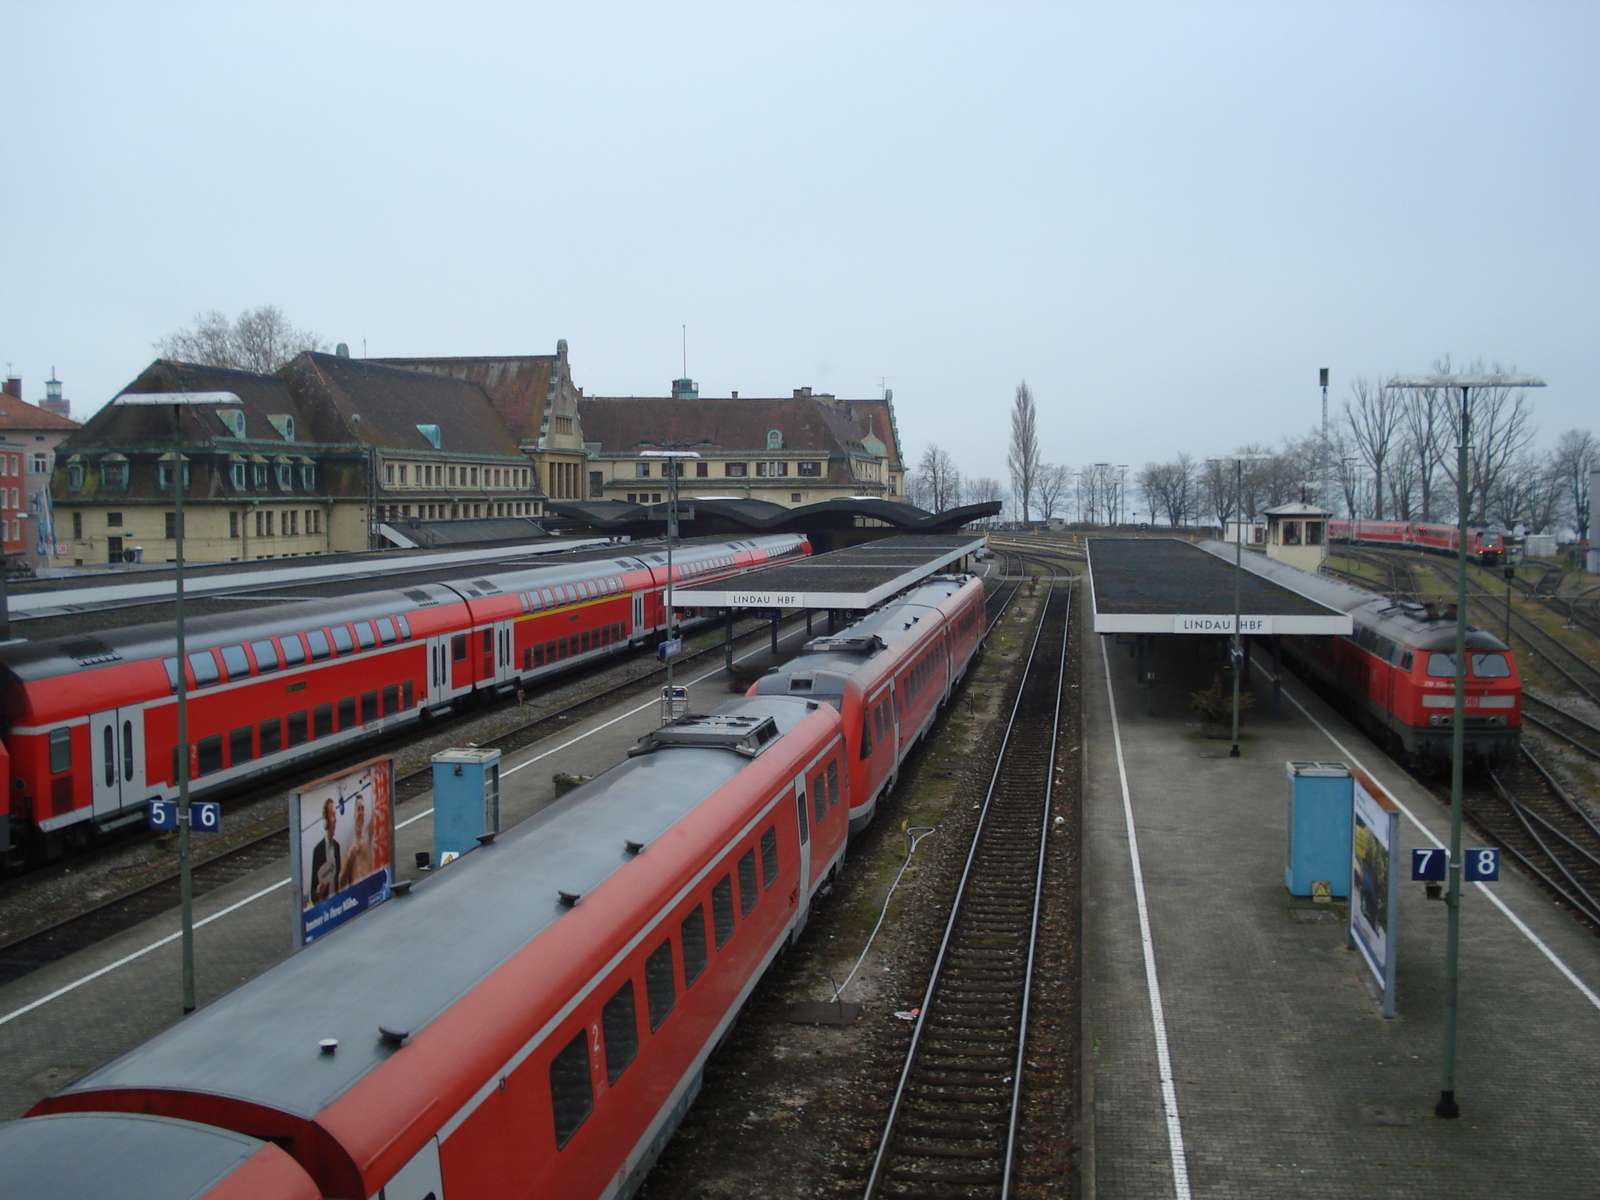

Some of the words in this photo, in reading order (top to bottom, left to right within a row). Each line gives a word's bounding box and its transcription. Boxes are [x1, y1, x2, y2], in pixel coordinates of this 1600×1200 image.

[733, 595, 770, 604] LINDAU
[777, 596, 796, 605] HBF
[686, 608, 692, 617] 5
[845, 611, 852, 619] 6
[1184, 620, 1231, 630] LINDAU
[1240, 620, 1263, 630] HBF
[152, 802, 166, 825] 5
[201, 804, 216, 827] 6
[1416, 850, 1433, 874] 7
[1478, 850, 1495, 875] 8
[592, 1024, 600, 1052] 2
